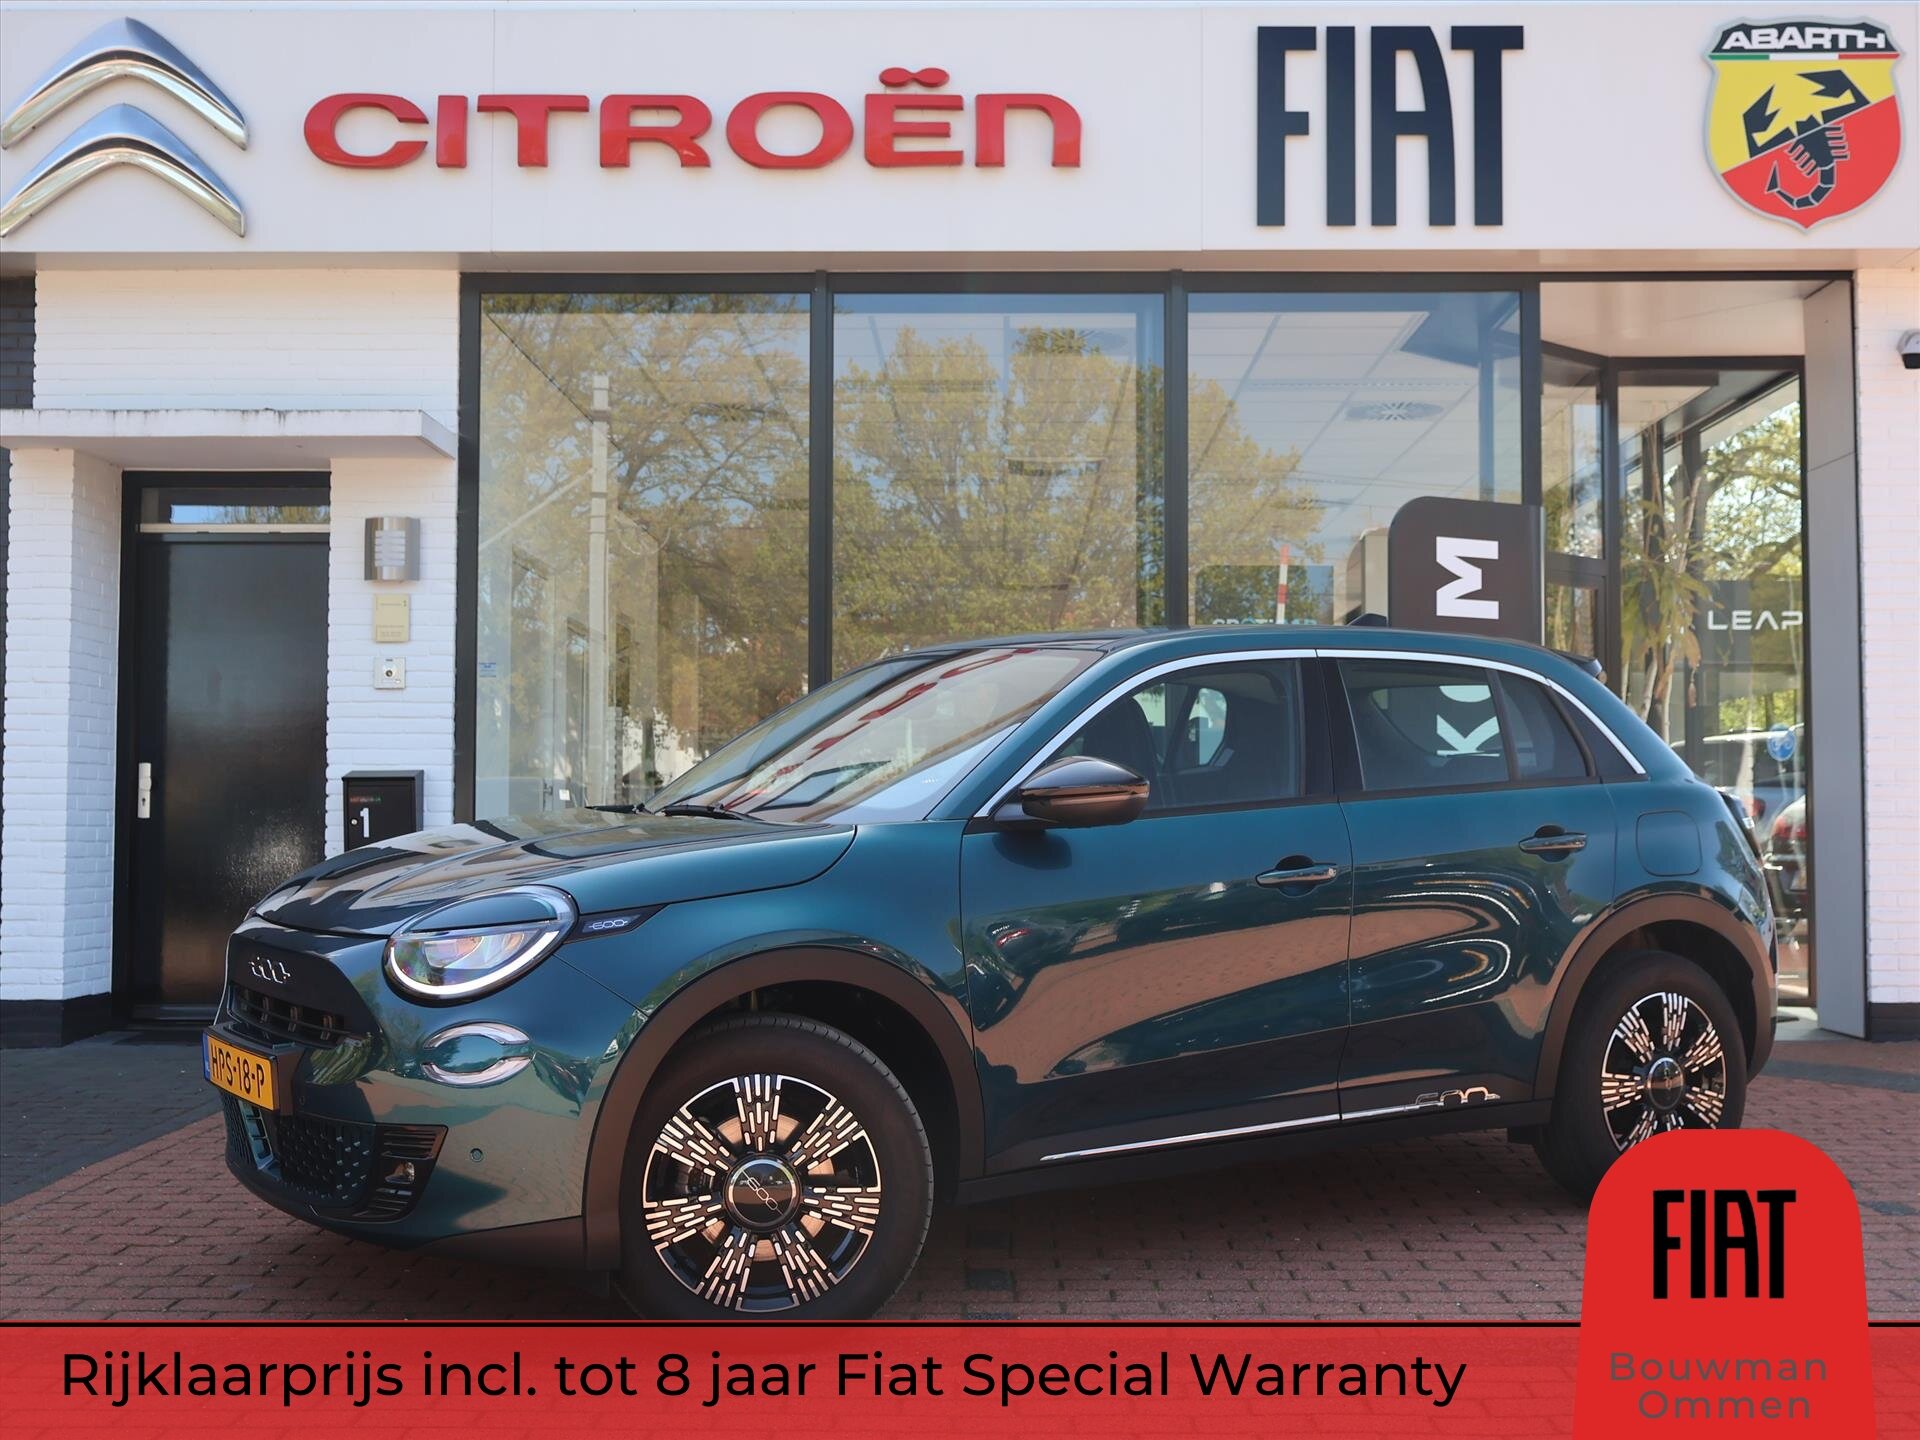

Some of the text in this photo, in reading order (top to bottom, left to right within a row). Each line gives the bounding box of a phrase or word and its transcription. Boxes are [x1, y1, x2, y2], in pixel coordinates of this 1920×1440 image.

[1721, 26, 1886, 50] ABARTH
[303, 67, 1082, 169] CITROËN
[1257, 26, 1524, 226] FIAT
[1707, 610, 1803, 631] LEAP
[360, 807, 370, 838] 1
[211, 1042, 265, 1099] HPS-18-P
